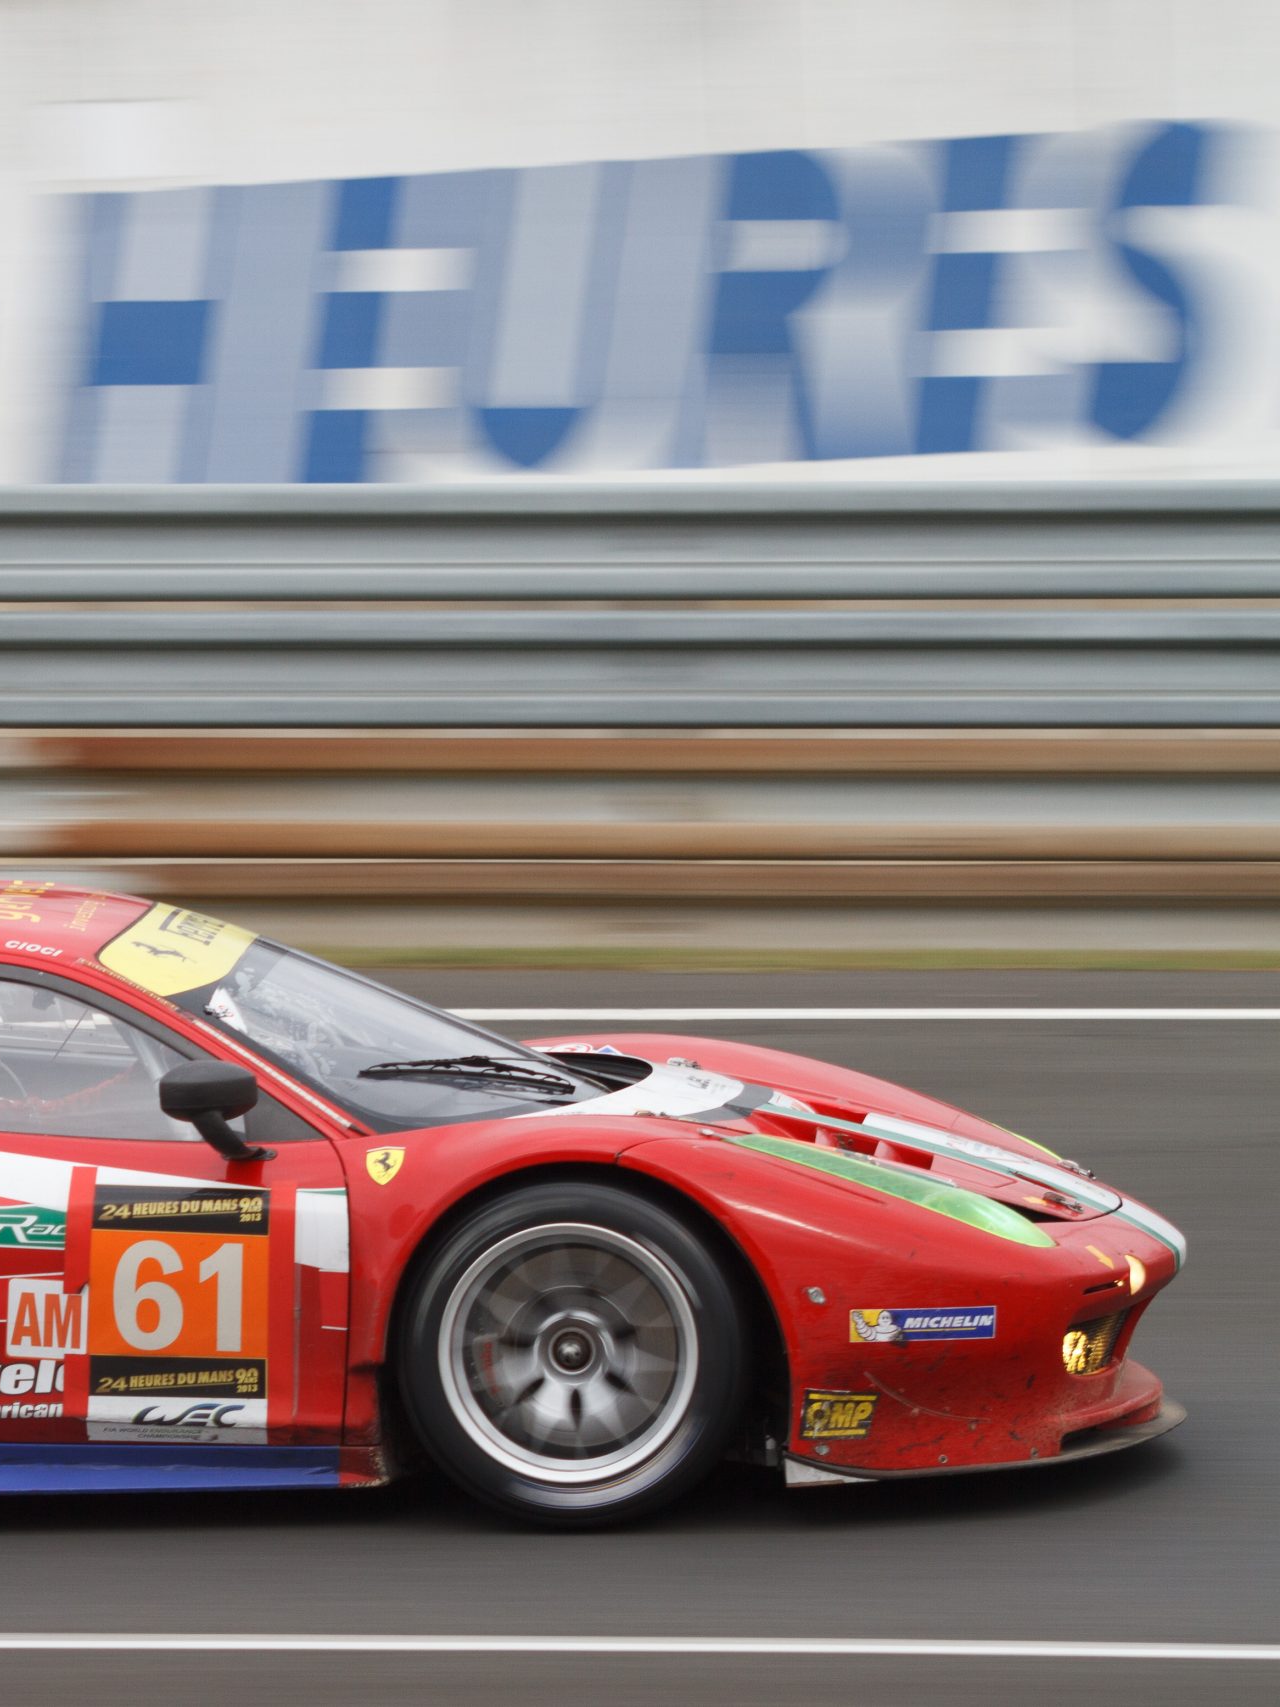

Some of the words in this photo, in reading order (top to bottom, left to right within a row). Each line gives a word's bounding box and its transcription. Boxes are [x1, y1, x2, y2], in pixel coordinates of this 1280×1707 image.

[55, 118, 1245, 485] HEURES
[4, 939, 64, 957] CIOCI
[98, 1204, 131, 1220] 24
[132, 1201, 179, 1216] HEURES
[181, 1199, 199, 1213] DU
[201, 1198, 238, 1212] MANS
[240, 1213, 262, 1222] 2013
[113, 1239, 244, 1352] 61
[11, 1292, 82, 1349] AM
[904, 1305, 994, 1328] MICHELIN
[96, 1377, 127, 1392] 24
[130, 1373, 175, 1387] HEURES
[177, 1371, 197, 1385] DU
[198, 1370, 234, 1383] MANS
[236, 1384, 258, 1392] 2013
[131, 1403, 246, 1428] WEC
[806, 1401, 873, 1428] OMP
